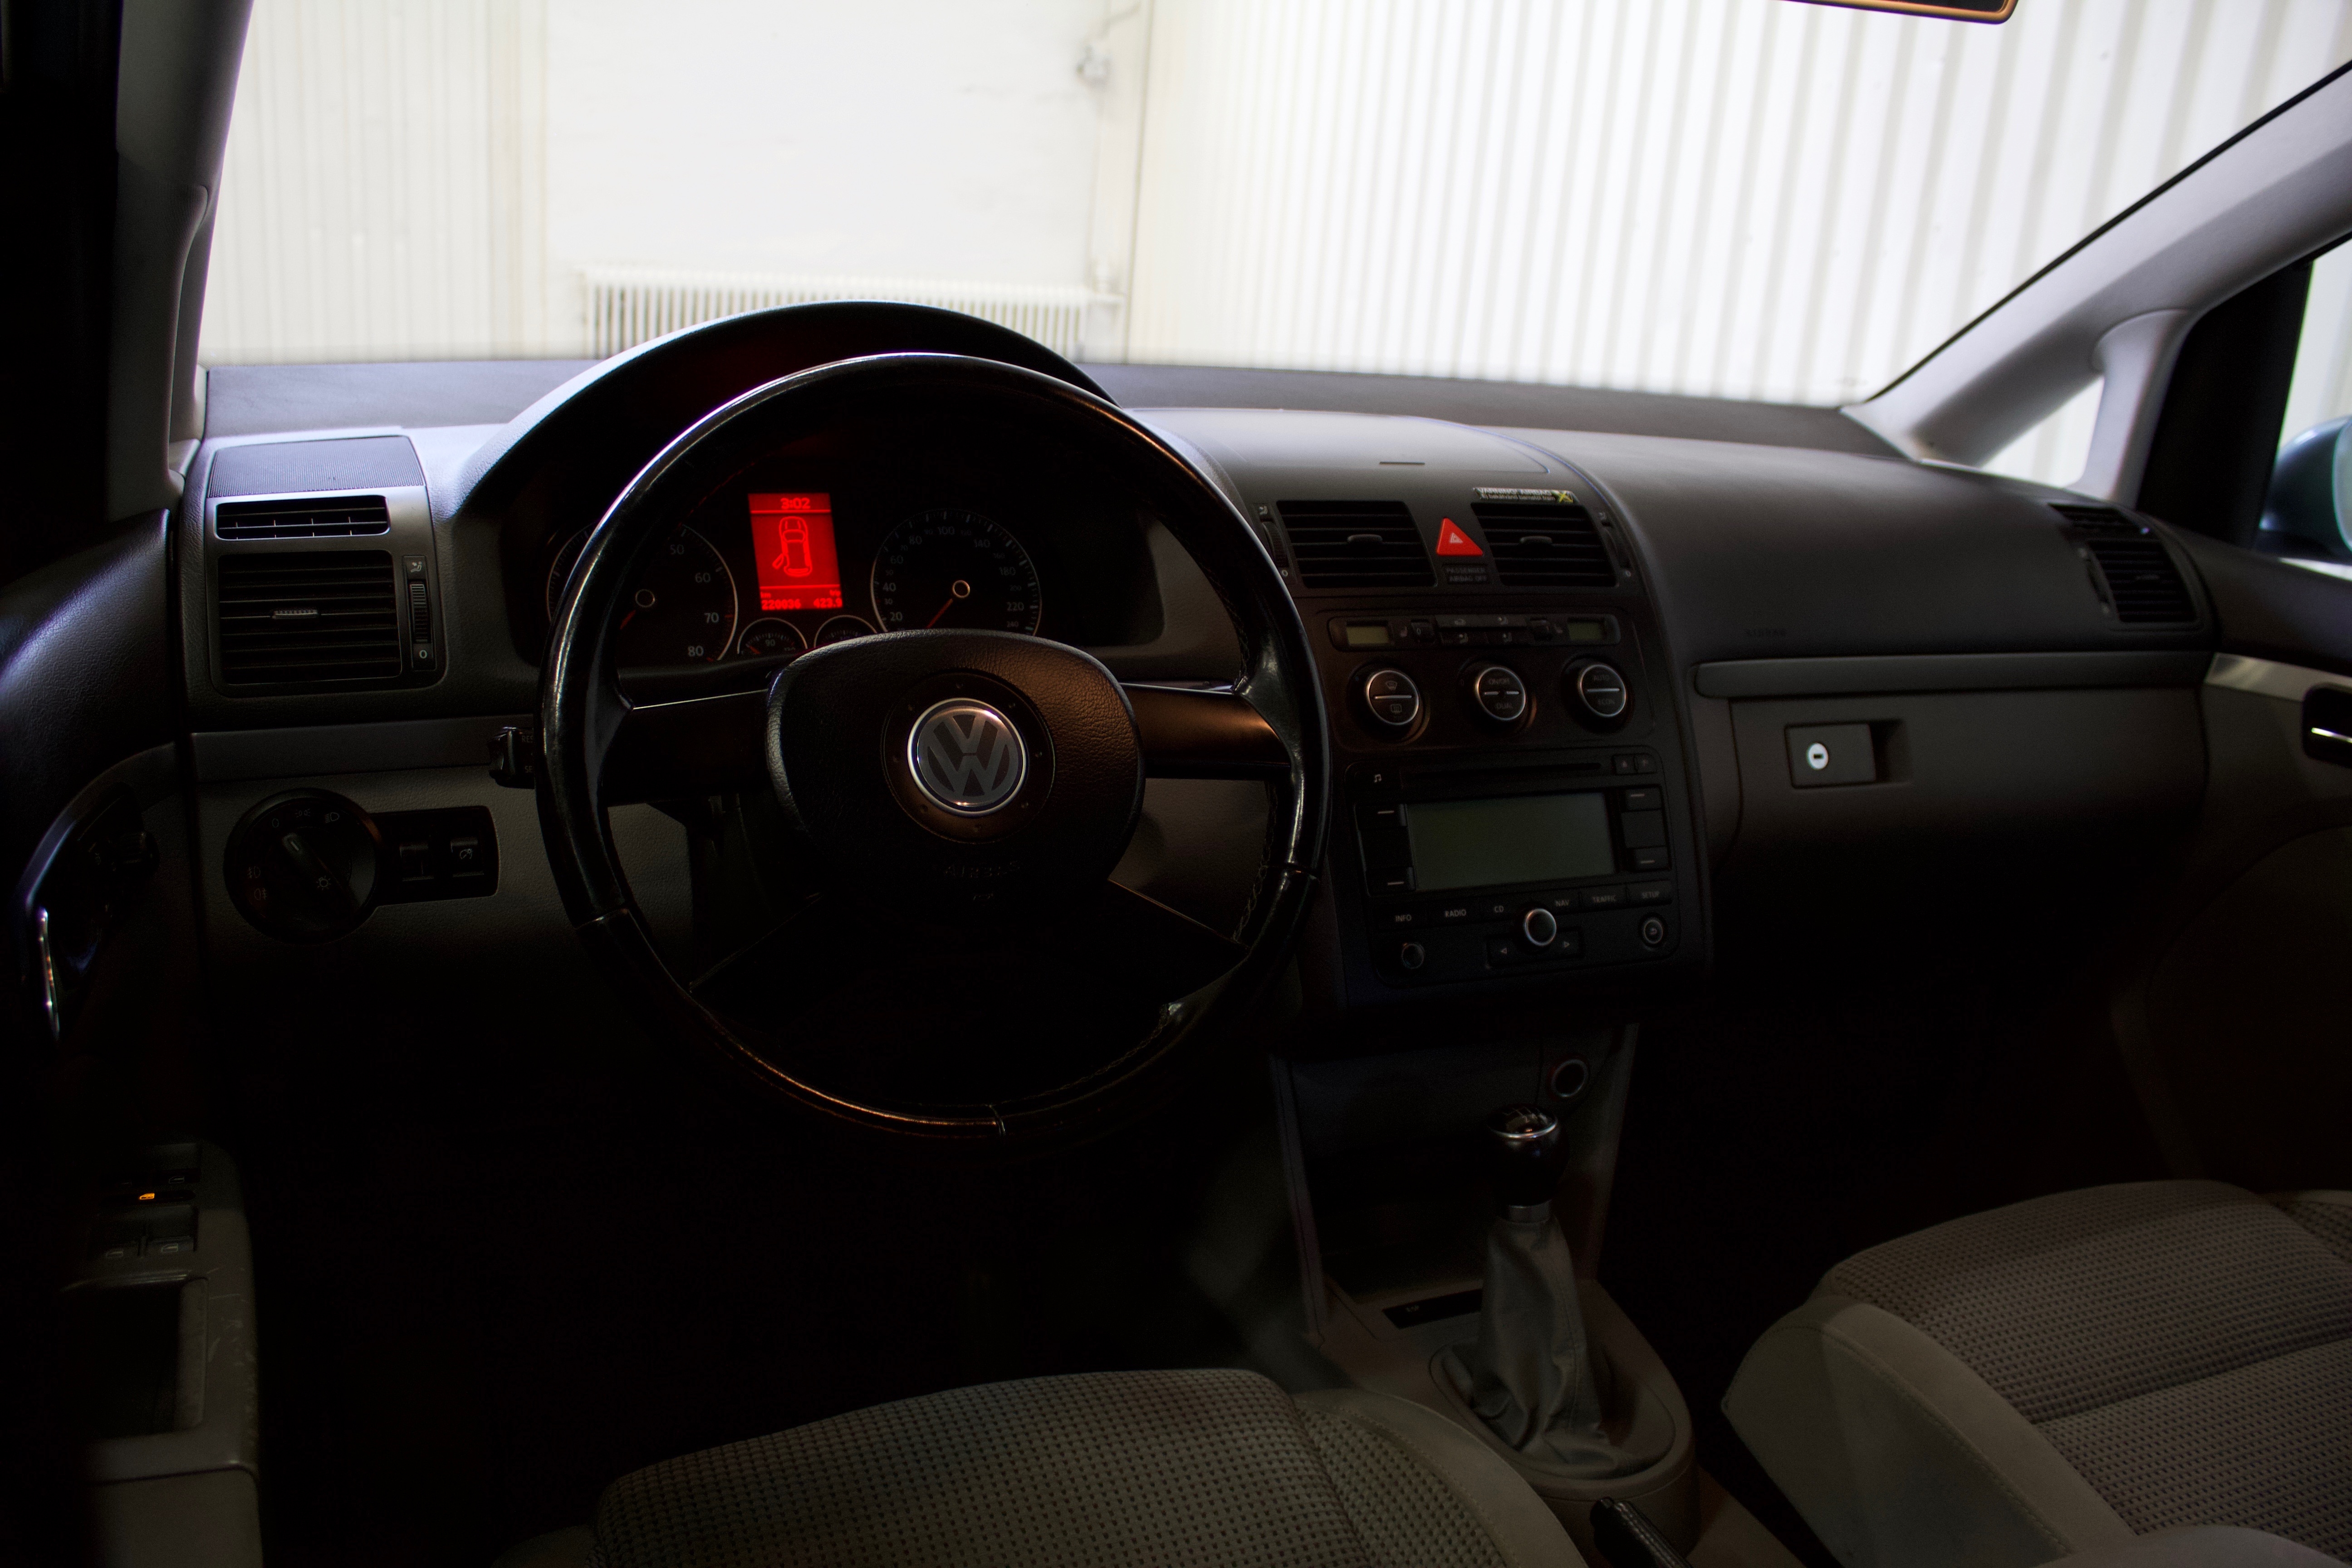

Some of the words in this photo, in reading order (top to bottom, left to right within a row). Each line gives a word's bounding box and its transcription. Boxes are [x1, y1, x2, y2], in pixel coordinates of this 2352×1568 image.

[780, 498, 810, 509] 3:02
[937, 526, 956, 536] 100
[909, 535, 922, 545] 80
[974, 539, 991, 548] 140
[670, 544, 685, 555] 50
[890, 555, 904, 565] 60
[999, 566, 1016, 576] 180
[695, 573, 711, 583] 60
[882, 583, 897, 592] 40
[762, 599, 801, 610] 220036
[813, 598, 843, 608] 423.9
[1007, 602, 1025, 612] 220
[703, 612, 720, 623] 70
[890, 612, 903, 622] 20
[687, 645, 704, 657] 80
[1641, 891, 1660, 899] SETUP
[1444, 909, 1467, 918] RADIO
[1494, 905, 1504, 913] CD
[1395, 914, 1412, 922] INFO
